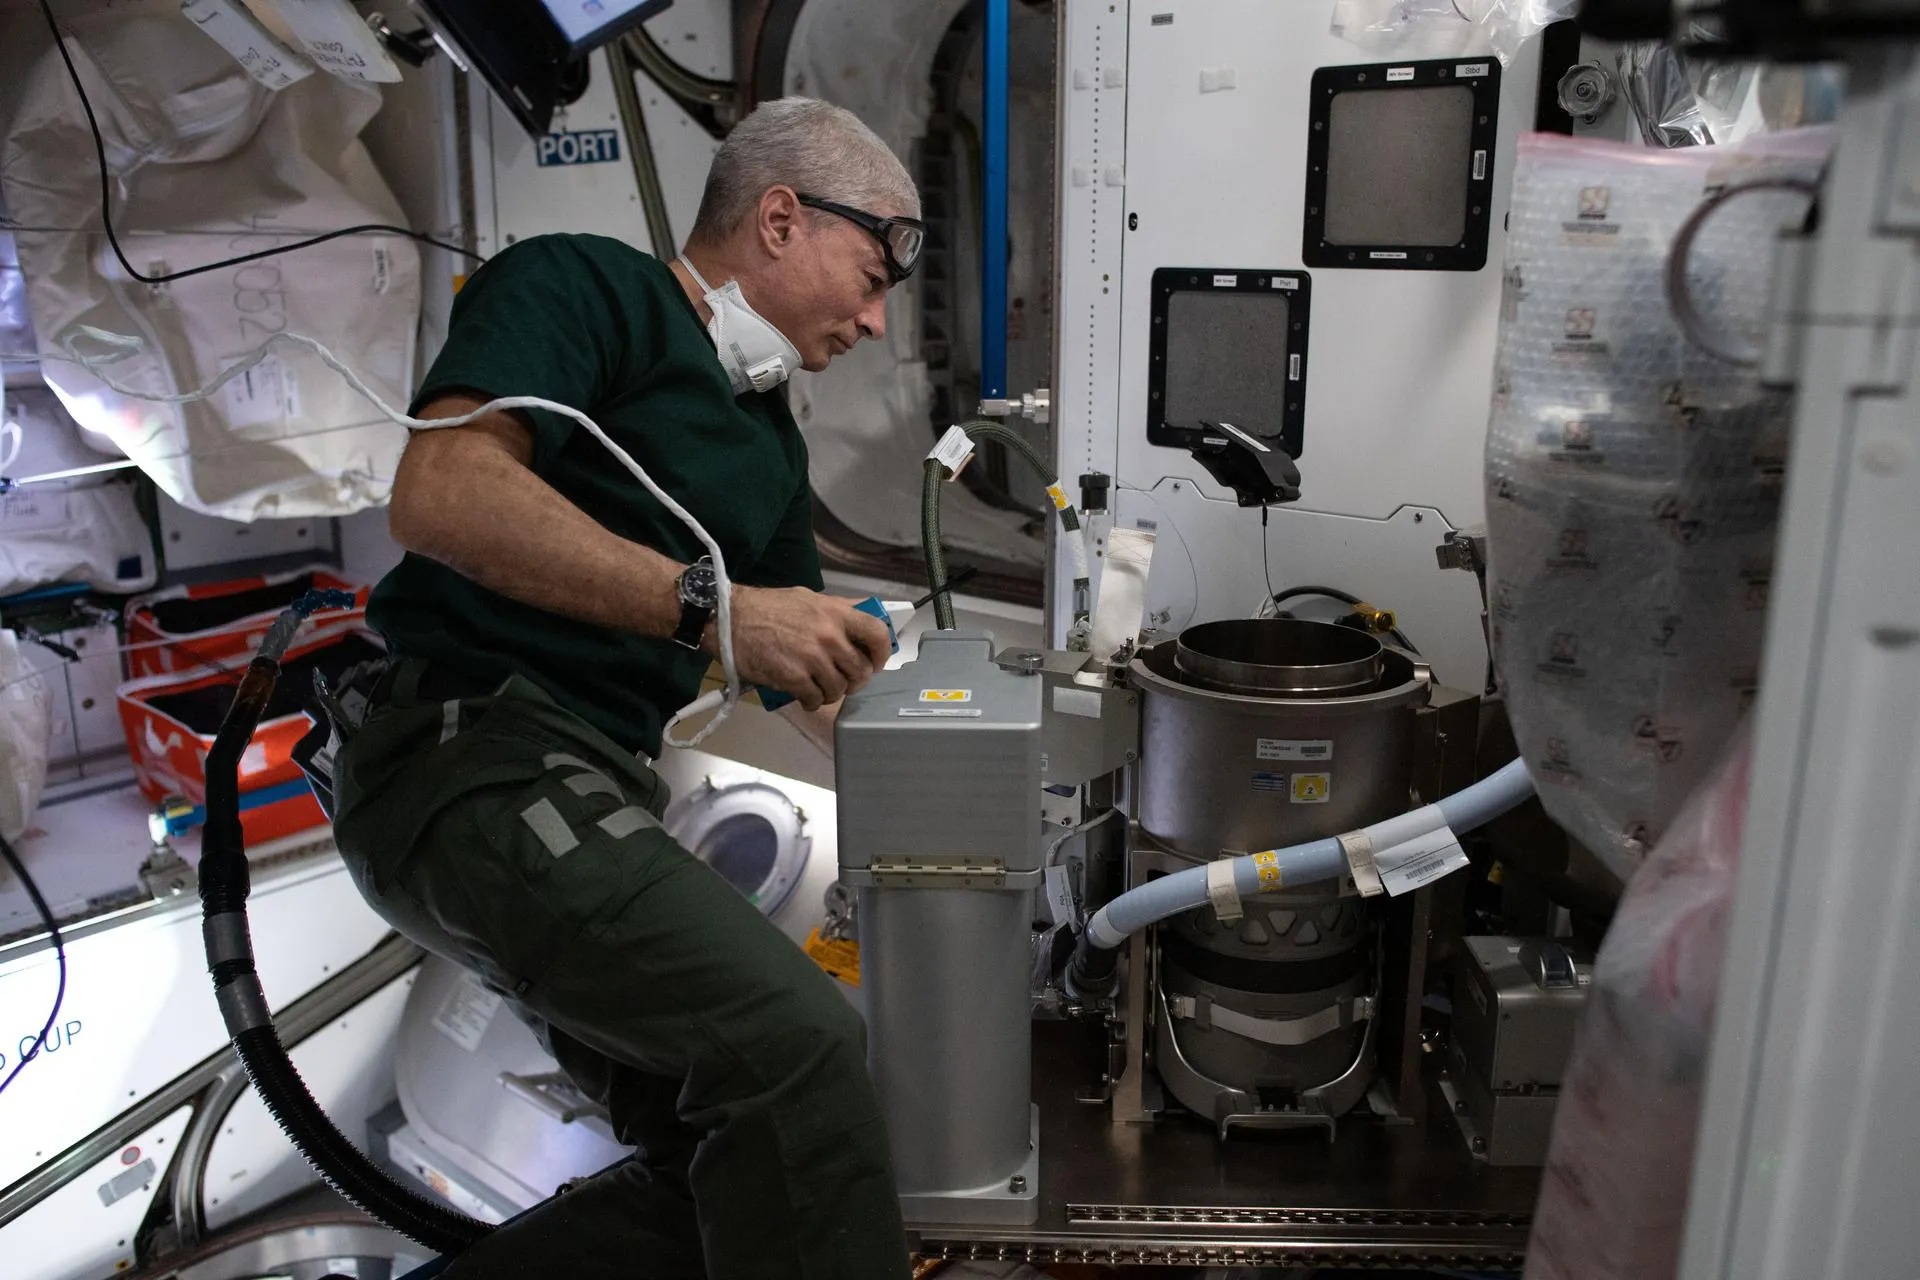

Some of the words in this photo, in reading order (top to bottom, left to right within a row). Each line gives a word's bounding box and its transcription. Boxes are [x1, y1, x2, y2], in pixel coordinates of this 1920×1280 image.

[539, 132, 615, 164] PORT
[1307, 786, 1314, 794] 2
[19, 1020, 82, 1063] CUP
